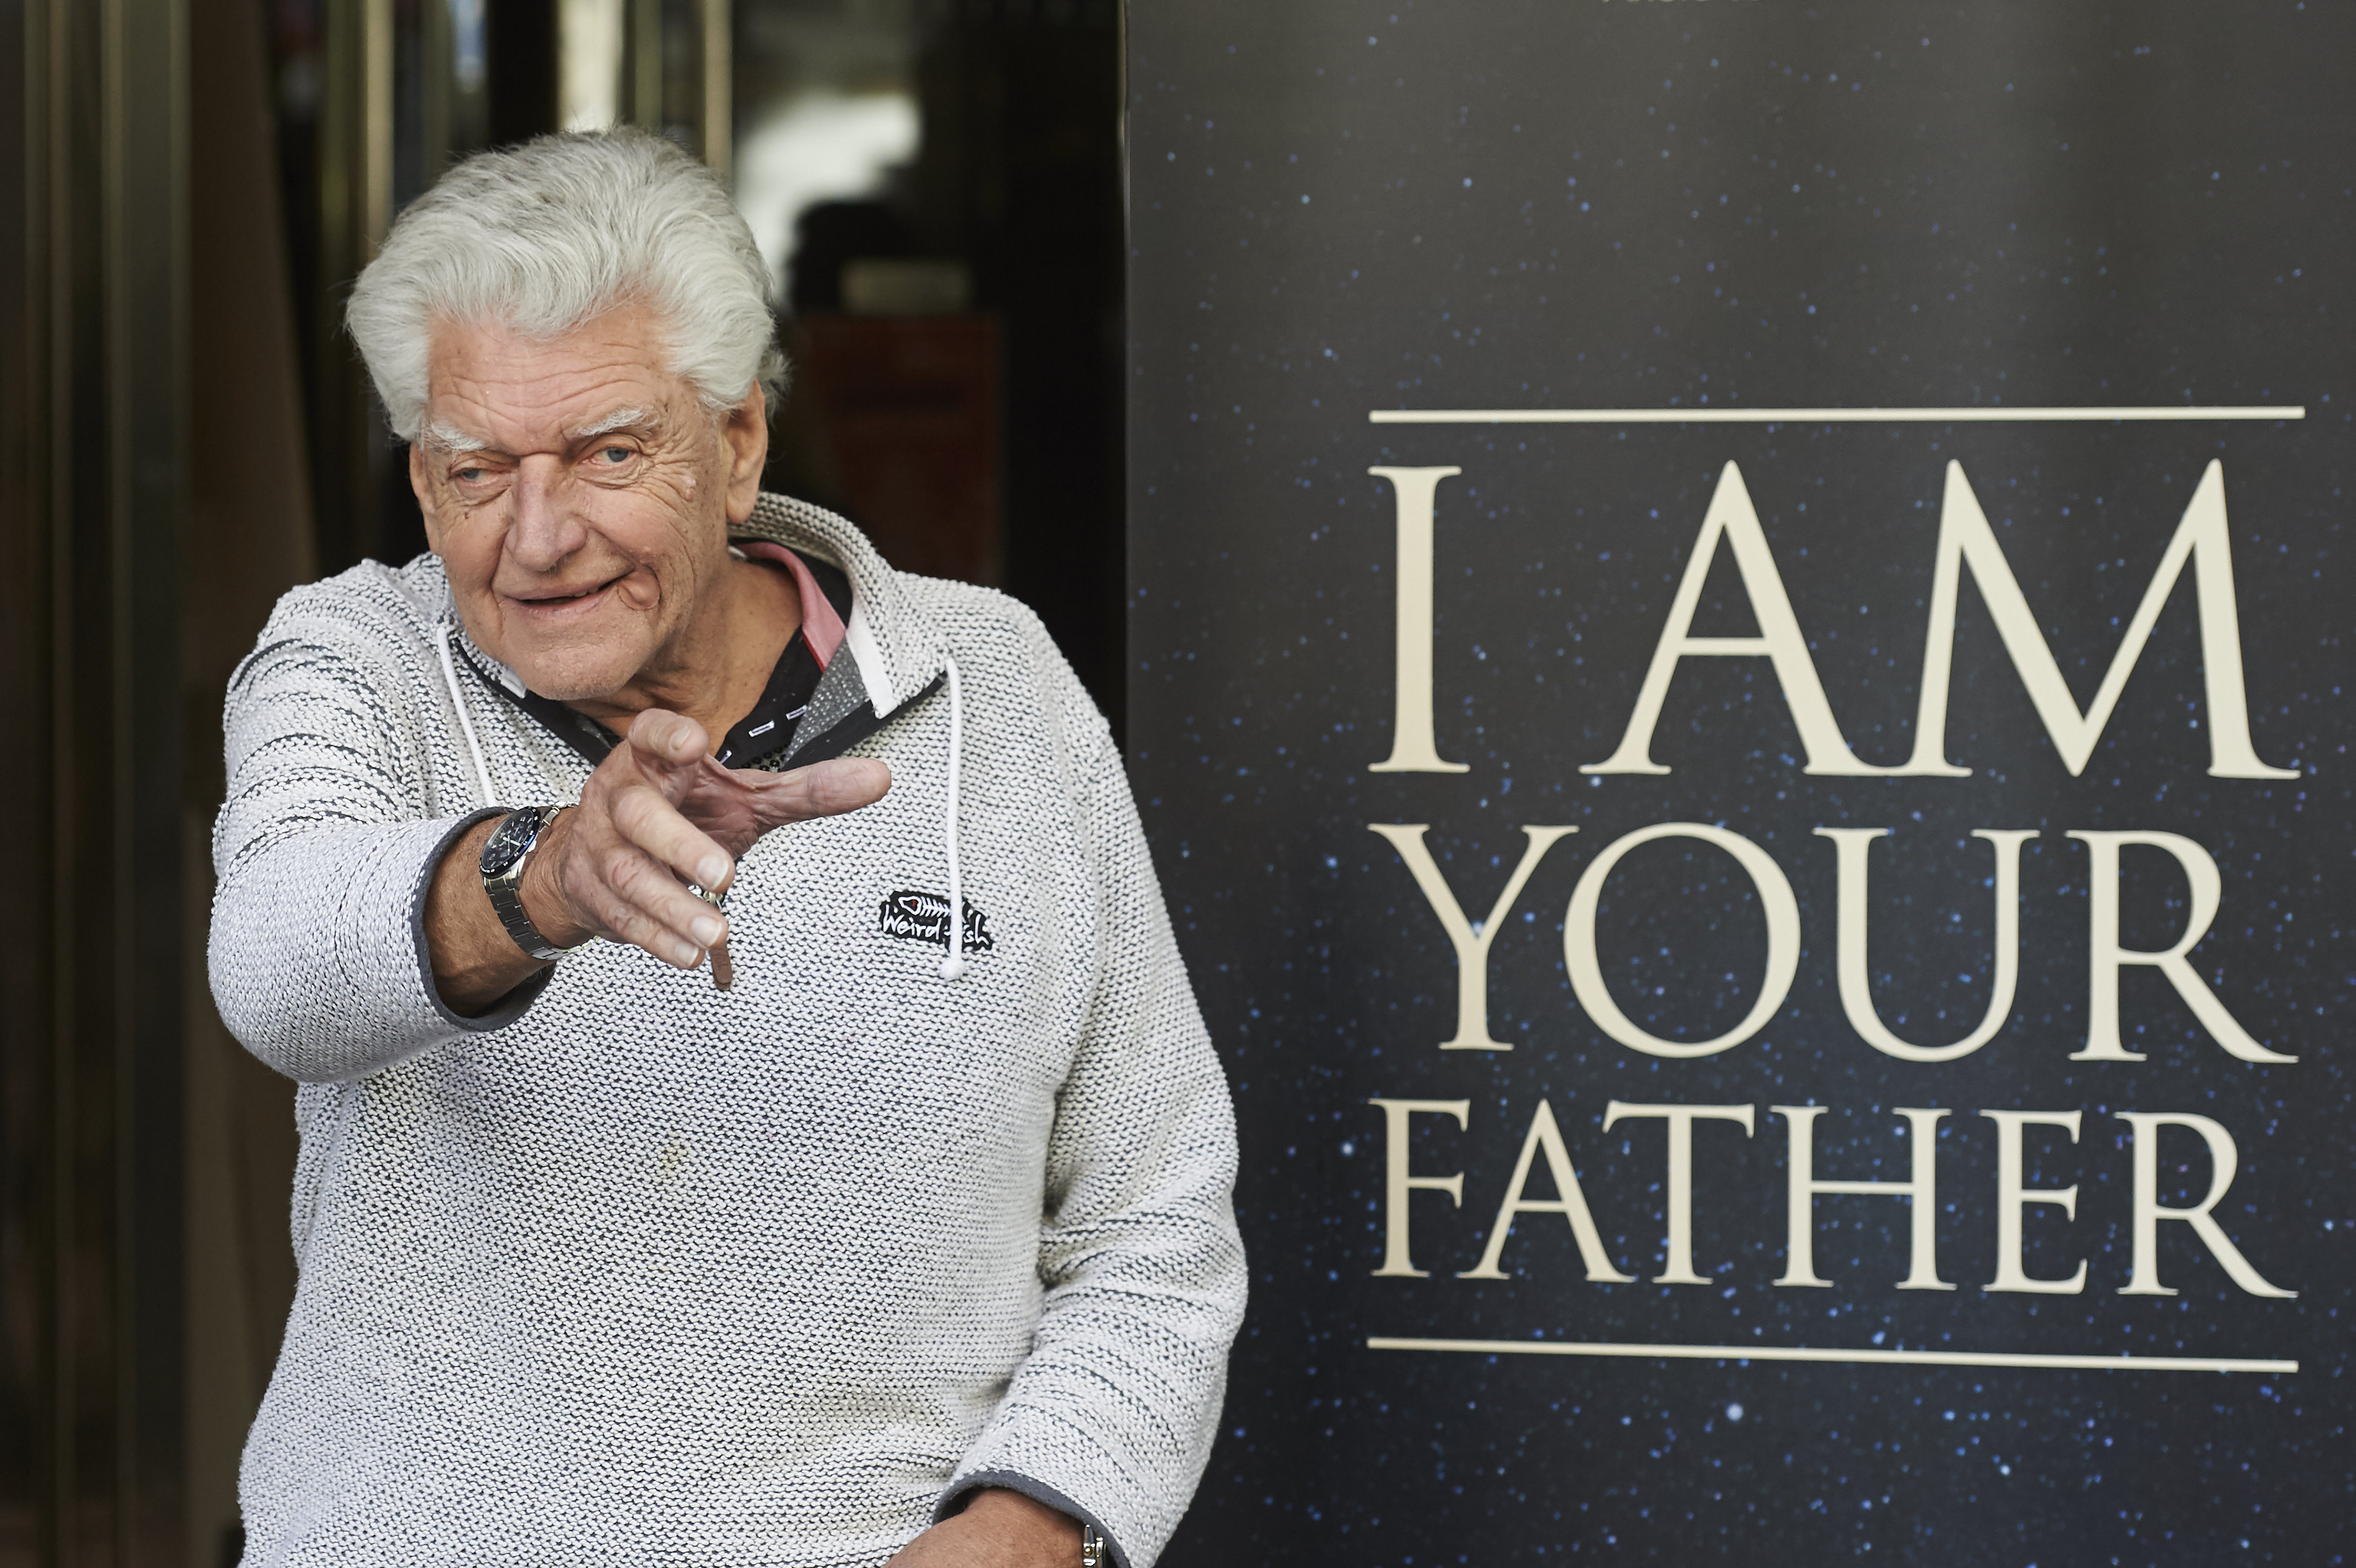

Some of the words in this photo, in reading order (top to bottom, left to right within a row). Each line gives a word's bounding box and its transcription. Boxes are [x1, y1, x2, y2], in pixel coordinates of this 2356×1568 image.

[1368, 465, 1471, 774] I
[1578, 458, 2301, 780] AM
[882, 903, 942, 940] Weird
[944, 913, 990, 945] sh
[1367, 822, 2299, 1064] YOUR
[1368, 1098, 2299, 1299] FATHER
